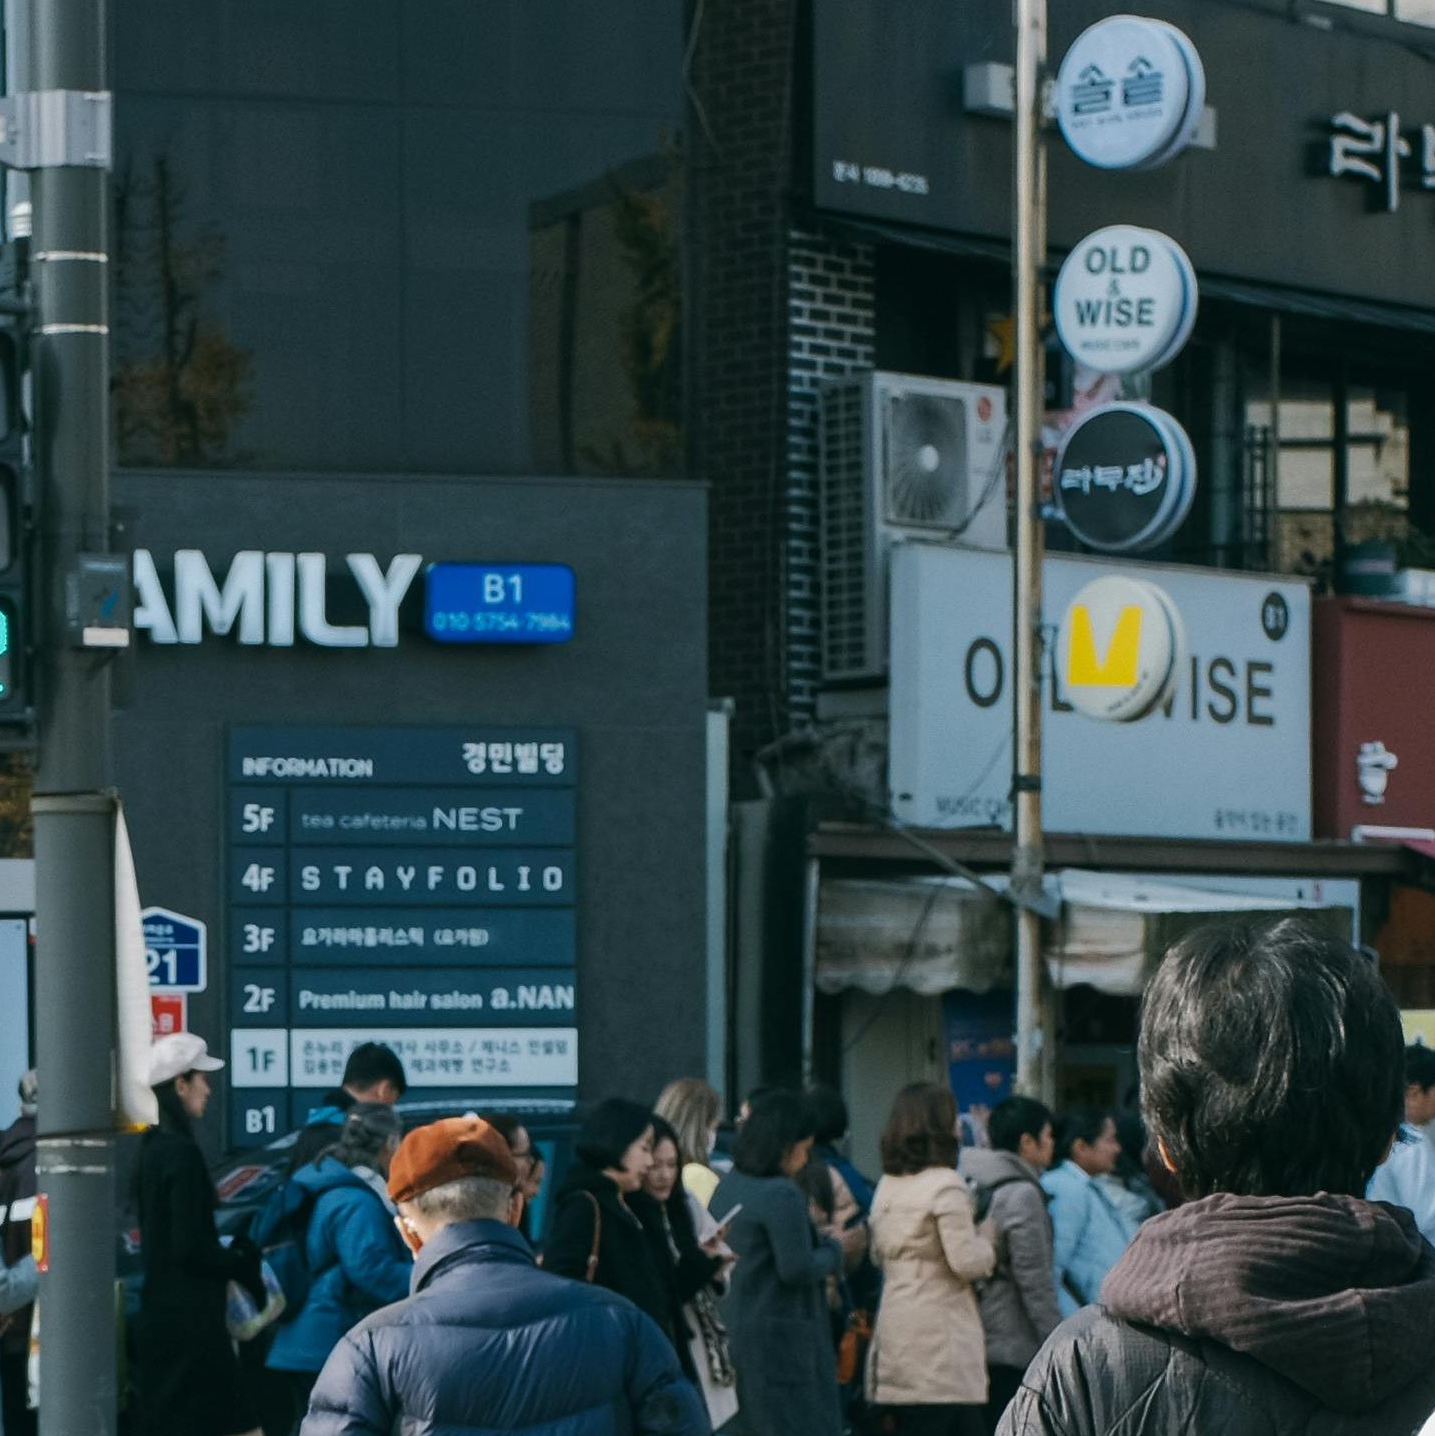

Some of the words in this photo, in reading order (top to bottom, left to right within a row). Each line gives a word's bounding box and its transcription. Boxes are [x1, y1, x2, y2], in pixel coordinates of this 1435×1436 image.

[1086, 247, 1150, 274] OLD
[1076, 298, 1155, 327] WISE
[1060, 457, 1163, 496] 라무진
[133, 548, 423, 648] AMILY
[483, 574, 522, 604] B1
[965, 637, 1075, 713] OL
[242, 757, 373, 778] INFORMATION
[462, 742, 565, 775] 경민빌딩
[242, 803, 276, 833] 5F
[301, 813, 335, 829] tea
[338, 812, 427, 830] cafeteria
[433, 807, 523, 831] NEST
[241, 863, 276, 892] 4F
[301, 866, 564, 892] STAYFOLIO
[242, 924, 276, 953] 3F
[242, 985, 276, 1013] 2F
[299, 990, 385, 1010] Premium
[389, 990, 428, 1010] hair
[430, 990, 483, 1010] salon
[490, 985, 575, 1010] a.NAN
[246, 1047, 276, 1074] 1F
[245, 1106, 276, 1134] B1
